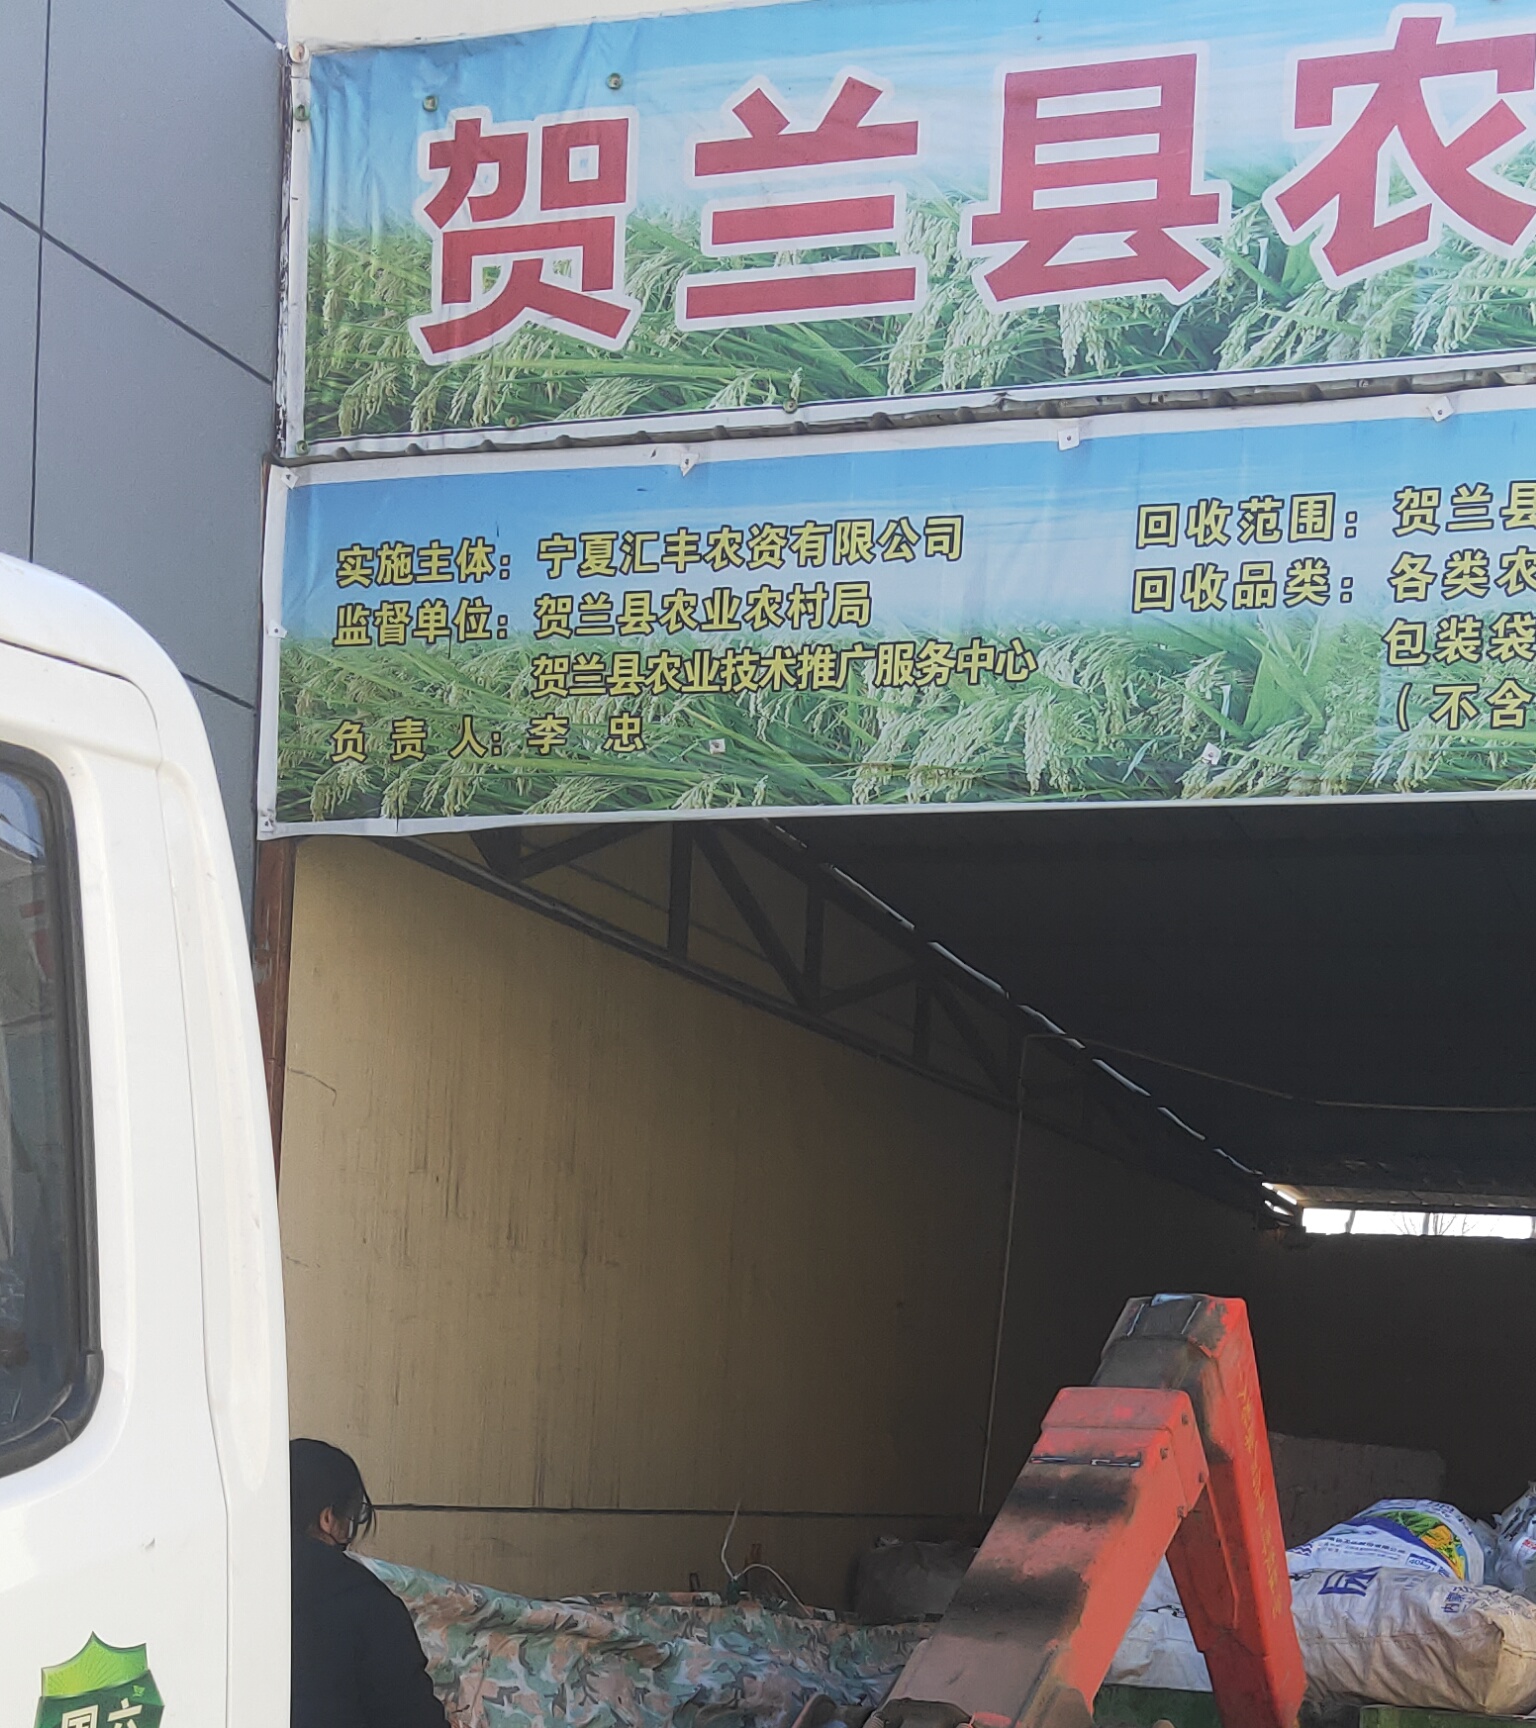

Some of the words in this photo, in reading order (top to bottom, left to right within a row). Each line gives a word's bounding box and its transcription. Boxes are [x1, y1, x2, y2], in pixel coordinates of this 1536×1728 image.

[530, 637, 1037, 700] 贺兰县农业技术推广服务中心
